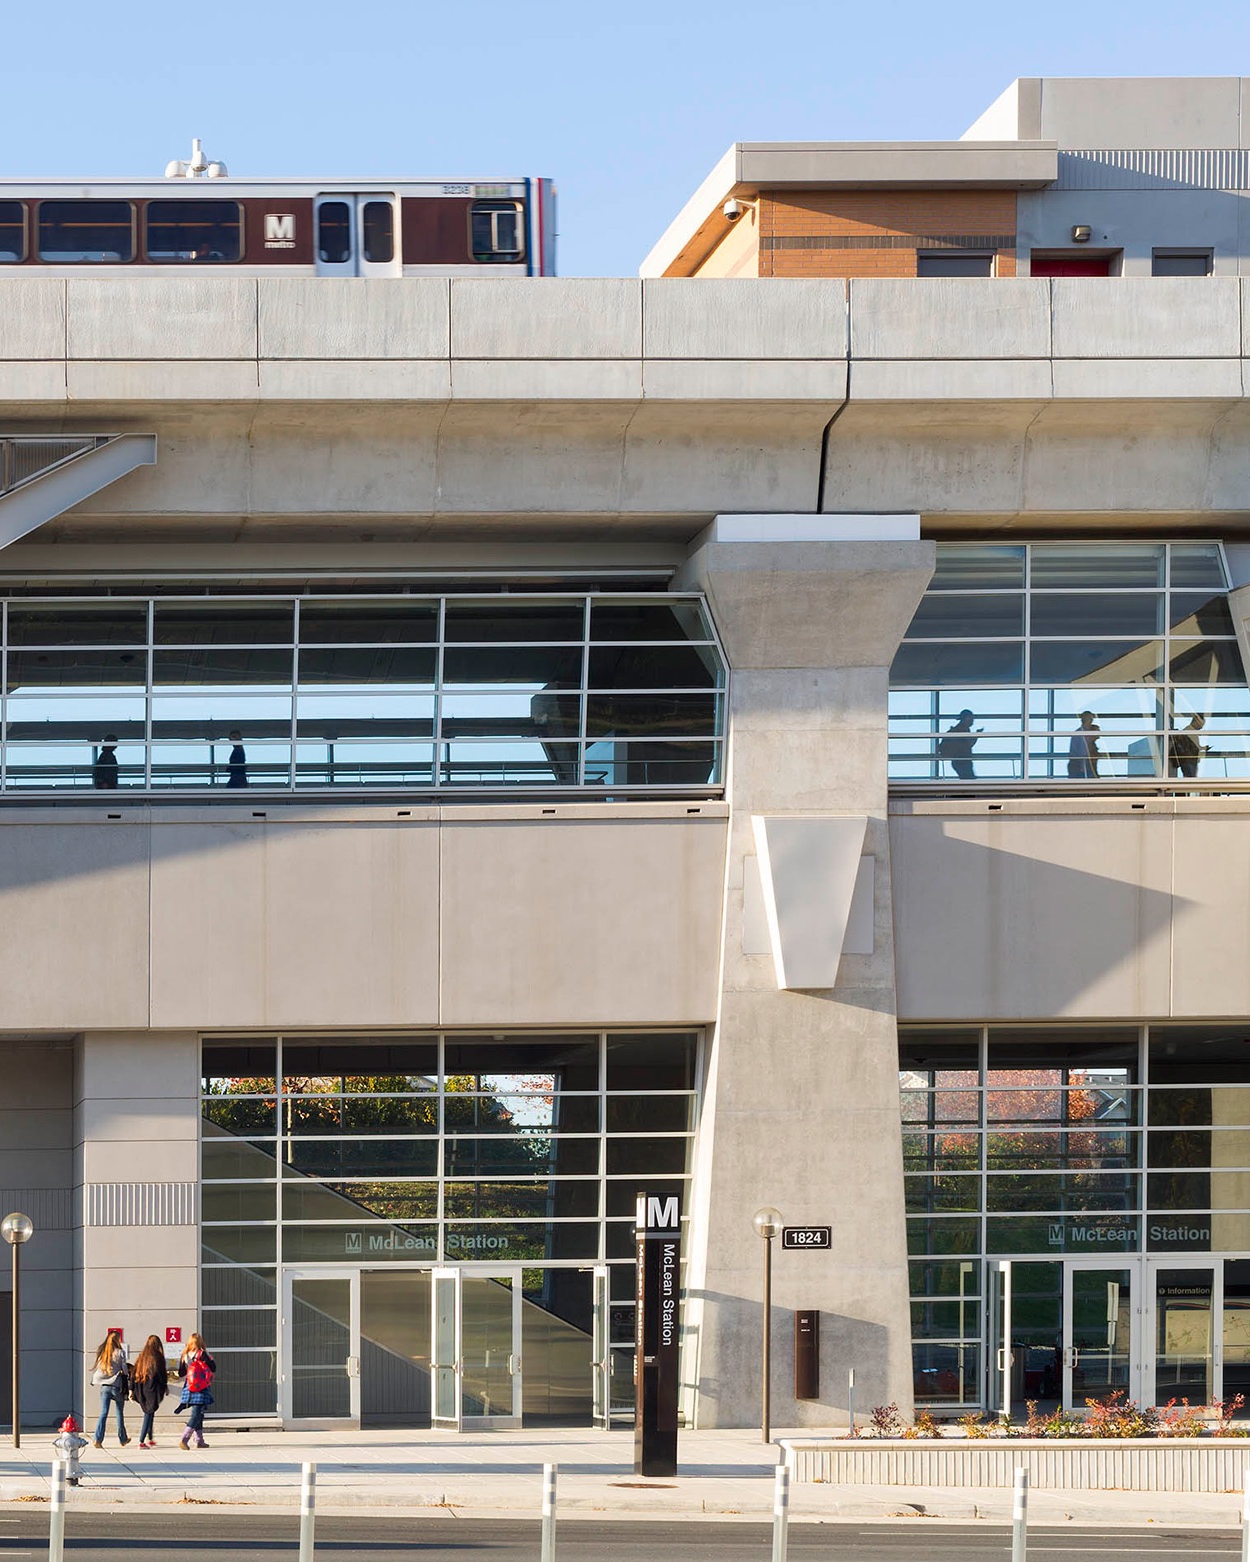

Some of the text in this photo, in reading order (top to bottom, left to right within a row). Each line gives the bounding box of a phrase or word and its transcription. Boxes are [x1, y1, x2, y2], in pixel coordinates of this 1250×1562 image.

[265, 215, 295, 239] M
[647, 1196, 679, 1228] M
[345, 1232, 509, 1251] M McLean Station
[791, 1231, 822, 1244] 1824
[1048, 1224, 1210, 1242] M McLean Station
[662, 1244, 675, 1346] McLean Station
[1167, 1287, 1211, 1295] Information
